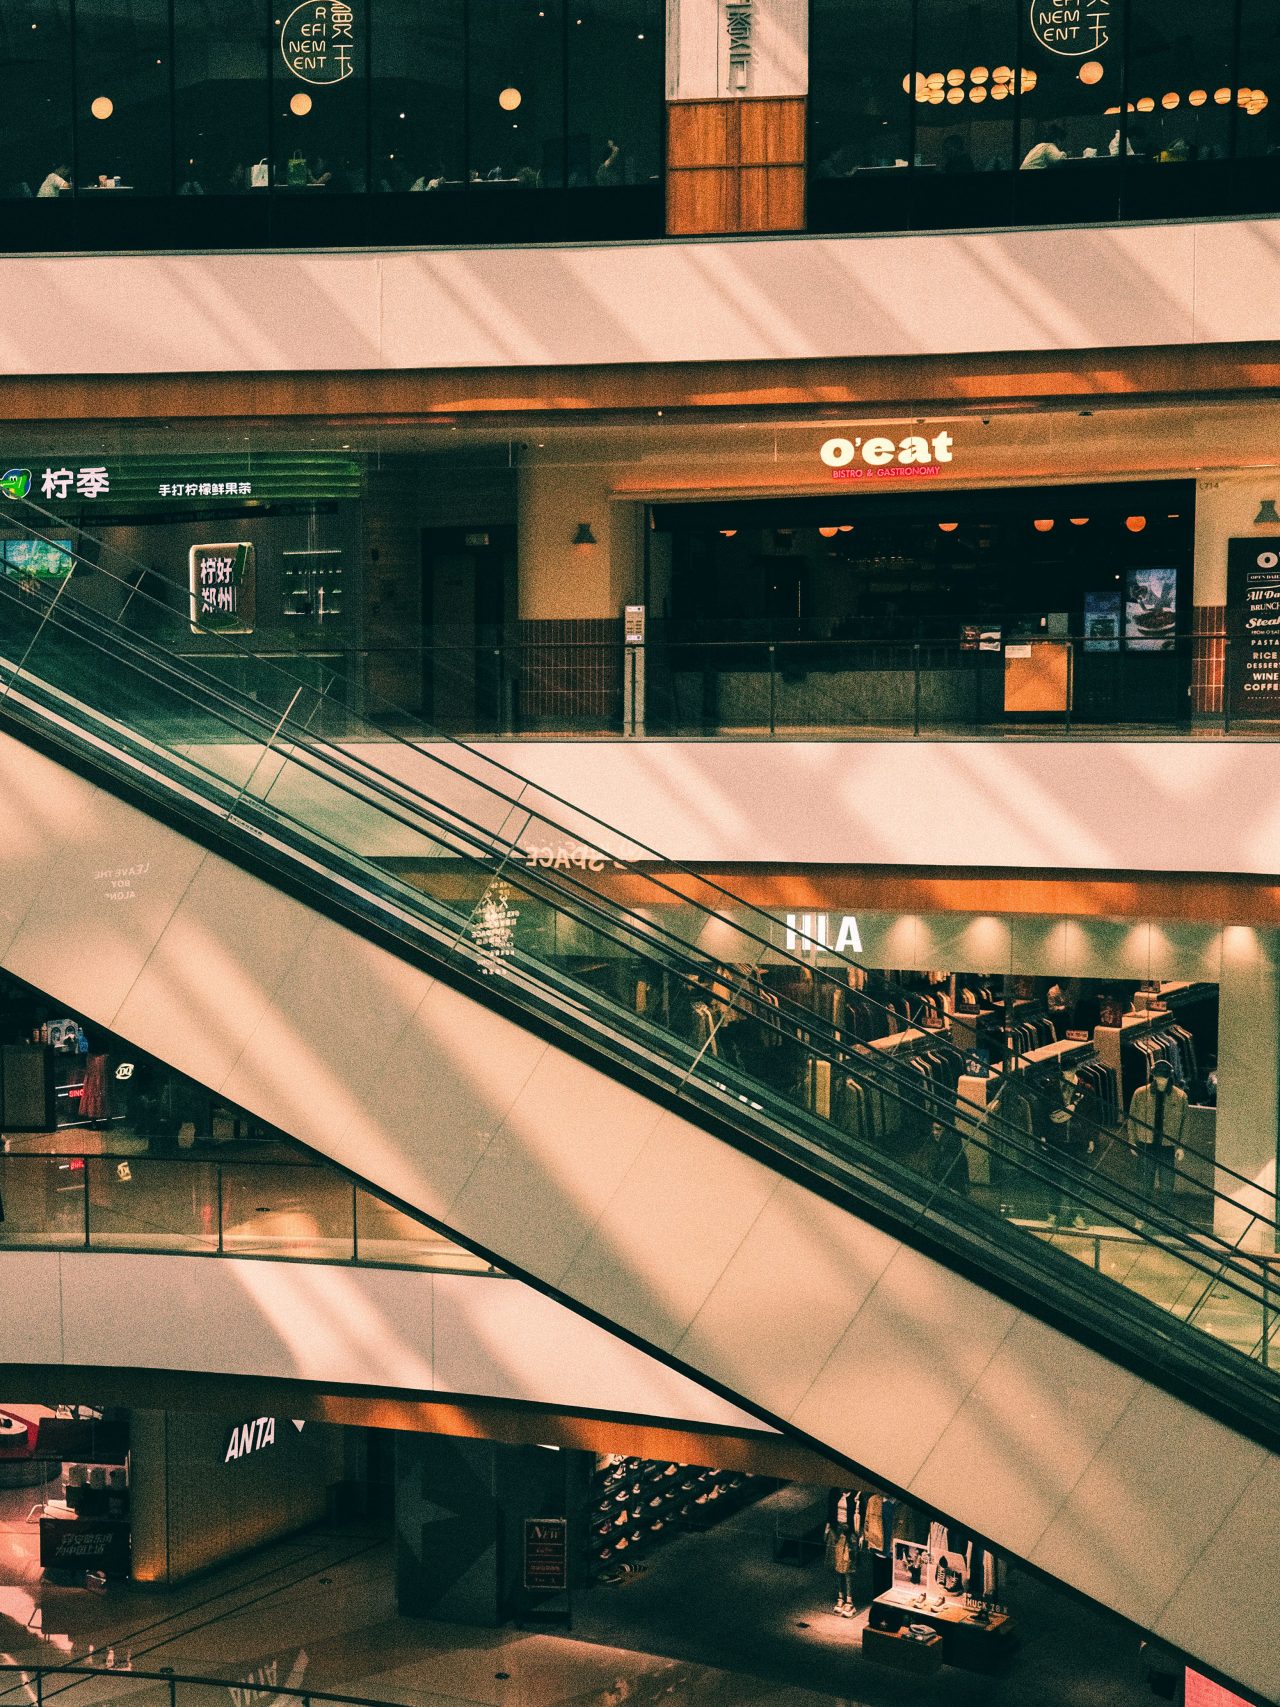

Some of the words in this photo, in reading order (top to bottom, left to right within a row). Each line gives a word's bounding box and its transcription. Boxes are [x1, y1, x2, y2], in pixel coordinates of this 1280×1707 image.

[315, 6, 326, 19] R
[1039, 9, 1080, 25] NEM
[301, 23, 326, 37] EFI
[1043, 26, 1081, 42] ENT
[289, 40, 326, 53] NEM
[725, 0, 752, 90] 餐厅
[293, 56, 327, 70] ENT
[820, 430, 953, 468] o'eat
[832, 468, 863, 479] BISTRO
[866, 468, 873, 478] &
[876, 465, 941, 477] GASTRONOMY
[40, 466, 110, 500] 柠季
[158, 481, 252, 497] 手打柠檬鲜果茶
[200, 557, 232, 585] 柠好
[1253, 651, 1278, 660] RICE
[1253, 672, 1279, 681] WINE
[1243, 683, 1280, 691] COFFE
[224, 1416, 275, 1463] ANTA
